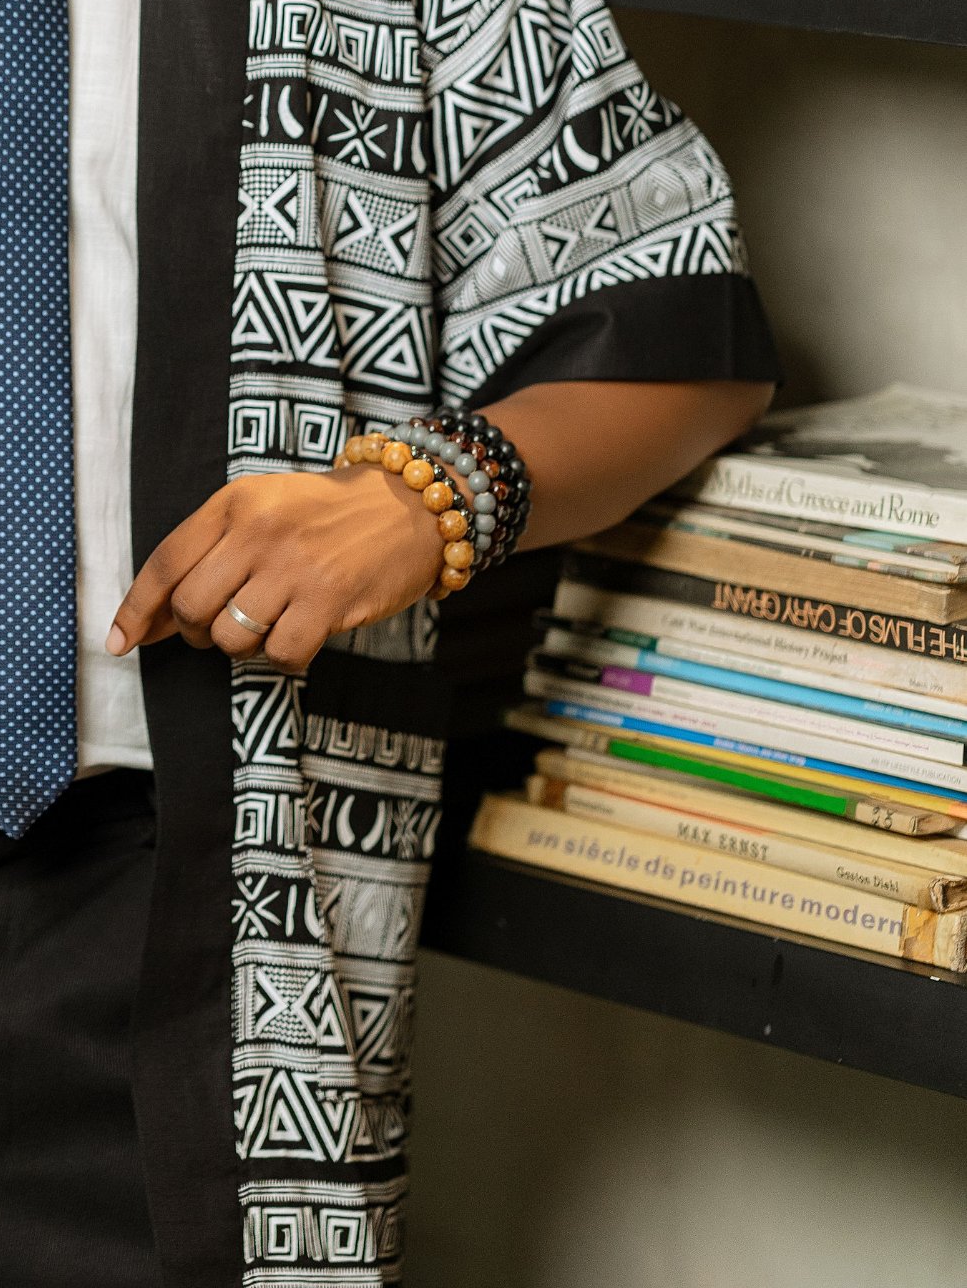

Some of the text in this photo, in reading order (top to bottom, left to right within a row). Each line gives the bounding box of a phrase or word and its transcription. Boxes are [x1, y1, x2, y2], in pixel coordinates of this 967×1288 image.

[710, 469, 940, 528] Myths of Greece and Rome
[712, 582, 781, 621] GRANT
[782, 597, 836, 634] CARY
[838, 609, 867, 641] OF
[869, 615, 926, 653] FILMS
[774, 637, 810, 658] History
[677, 822, 770, 861] MAX ERNST
[528, 829, 560, 850] un
[565, 835, 640, 872] siècle
[645, 855, 676, 880] de
[679, 868, 795, 910] peinture
[836, 866, 900, 894] Gaston Diehl
